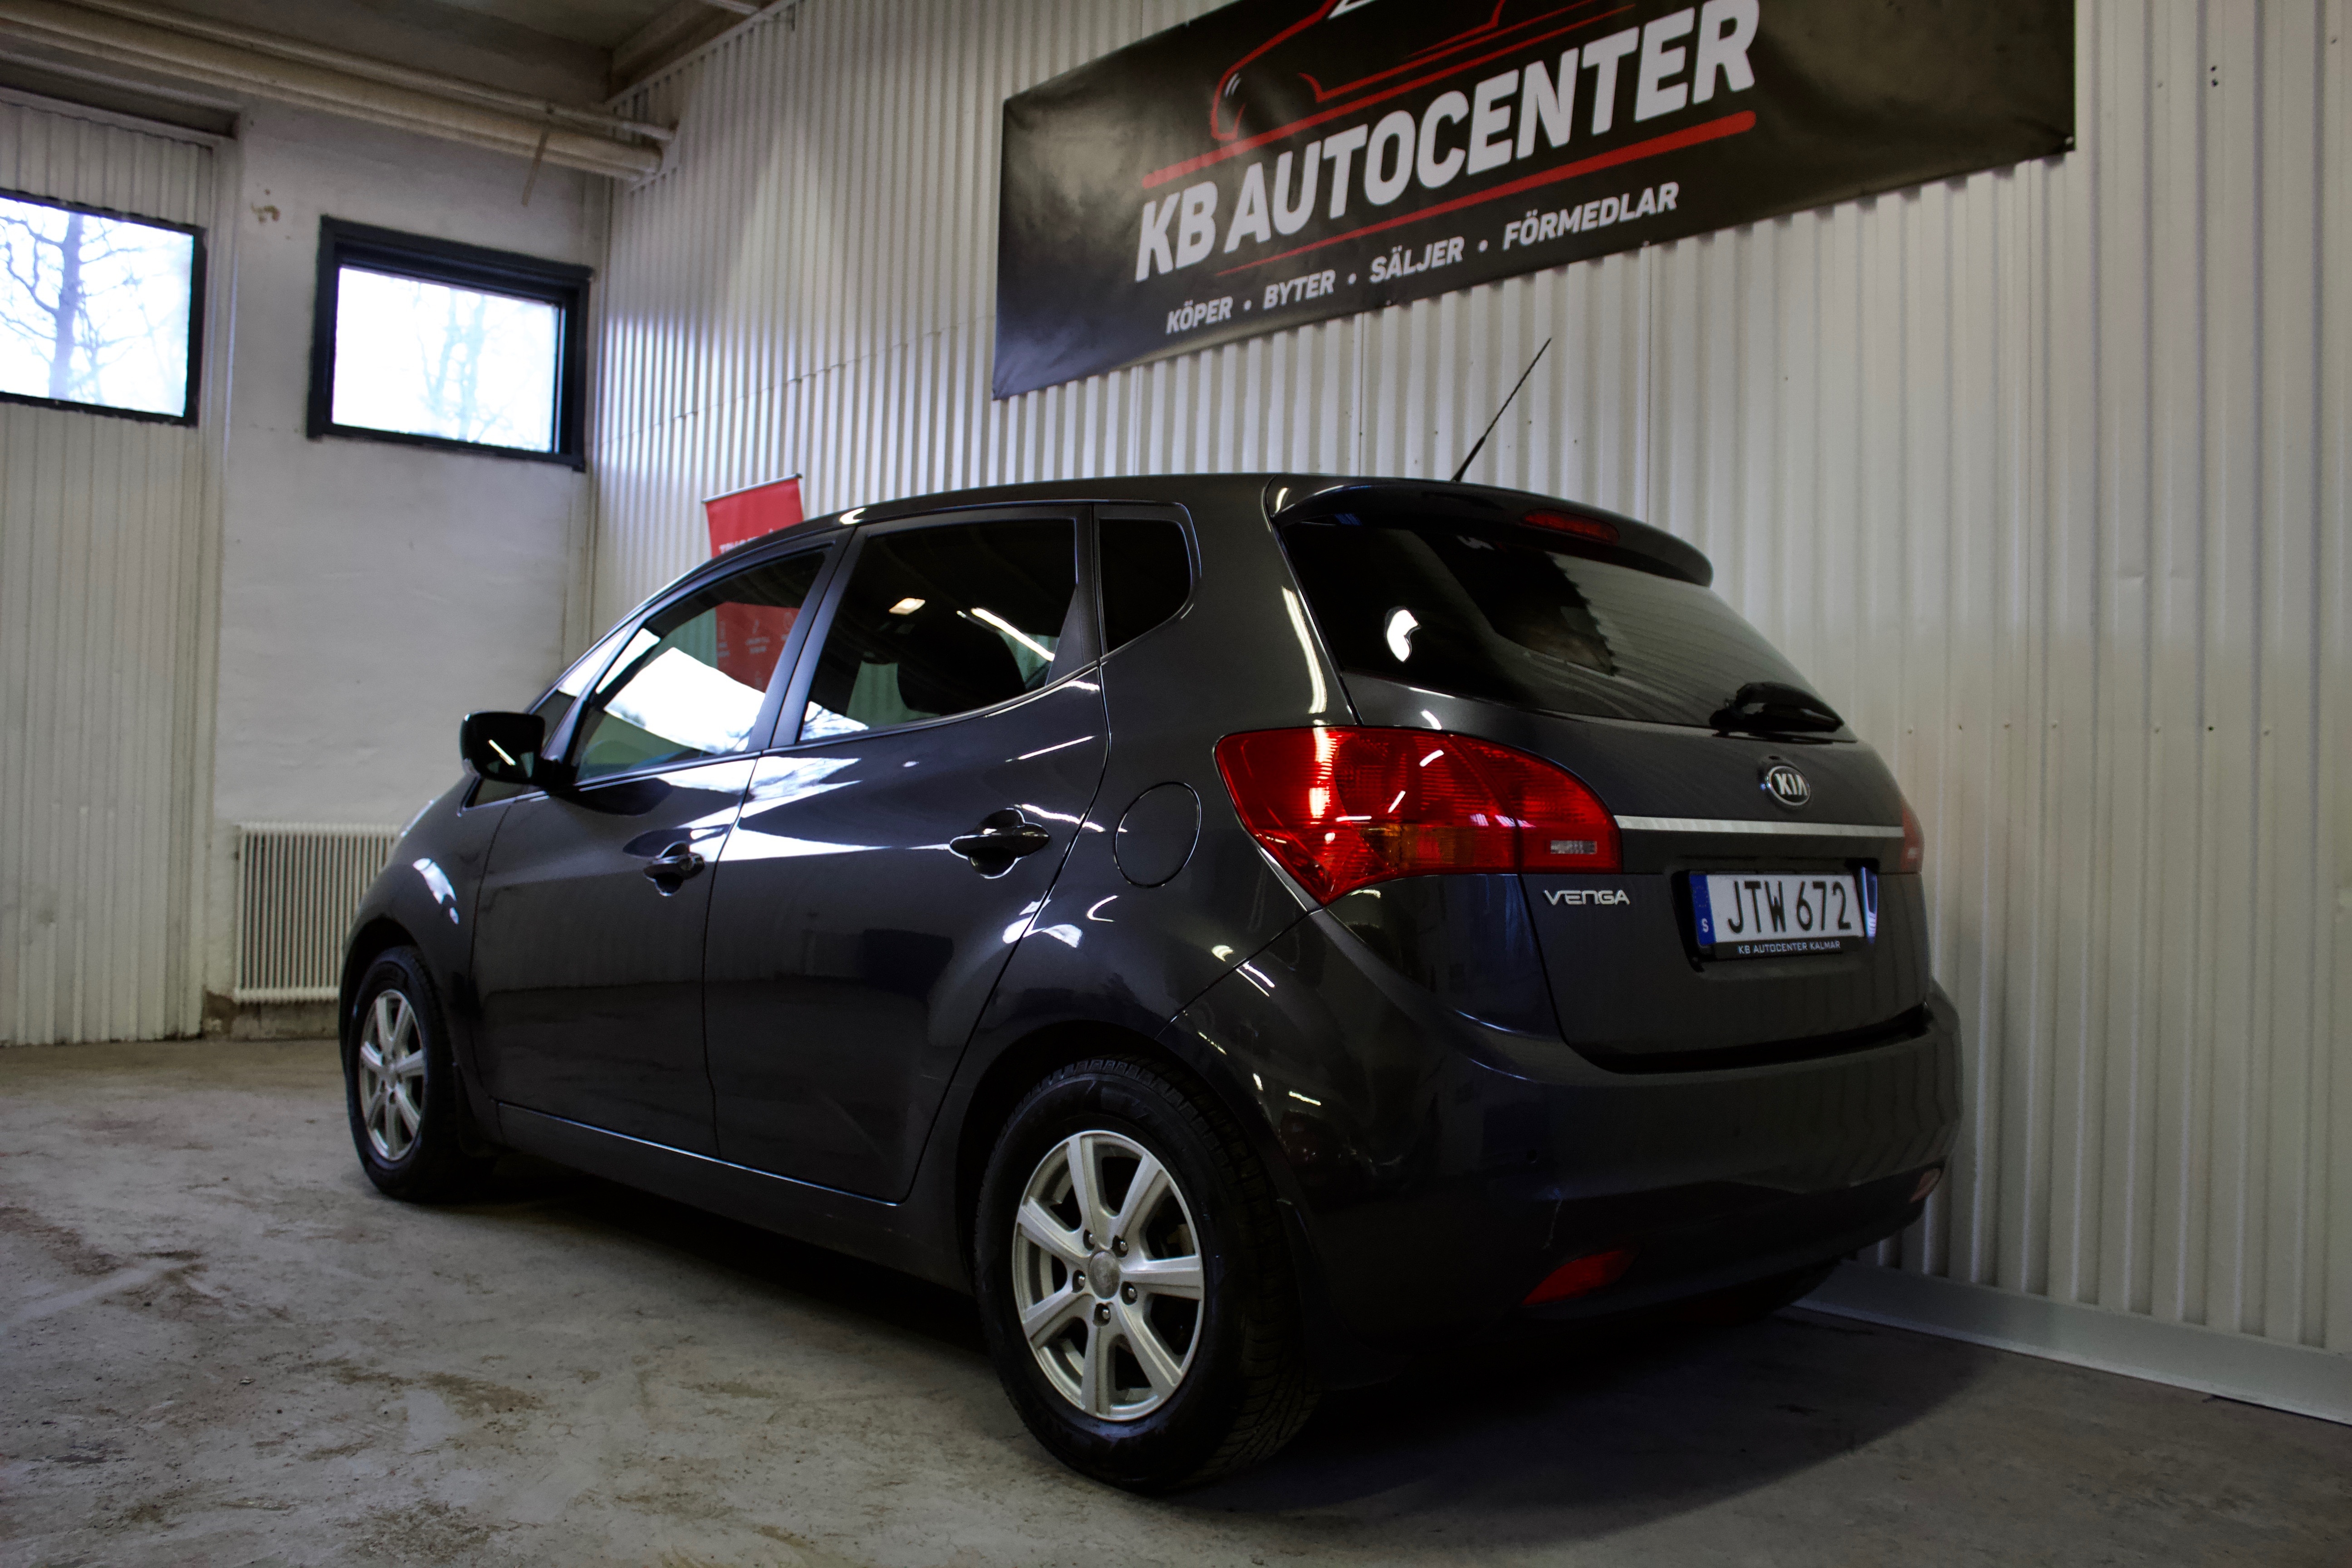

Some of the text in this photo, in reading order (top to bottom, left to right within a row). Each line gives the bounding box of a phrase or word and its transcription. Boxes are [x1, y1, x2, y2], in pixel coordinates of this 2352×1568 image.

[1136, 0, 1759, 282] KB AUTOCENTER
[1166, 181, 1679, 335] KÖPER BYTER SÄLJER FÖRMEDLAR
[1775, 773, 1808, 796] KIA
[1544, 889, 1630, 905] VENGA
[1728, 880, 1852, 933] JTW 672
[1701, 917, 1710, 933] S
[1738, 940, 1841, 954] KB AUTOCENTER KALMAR
